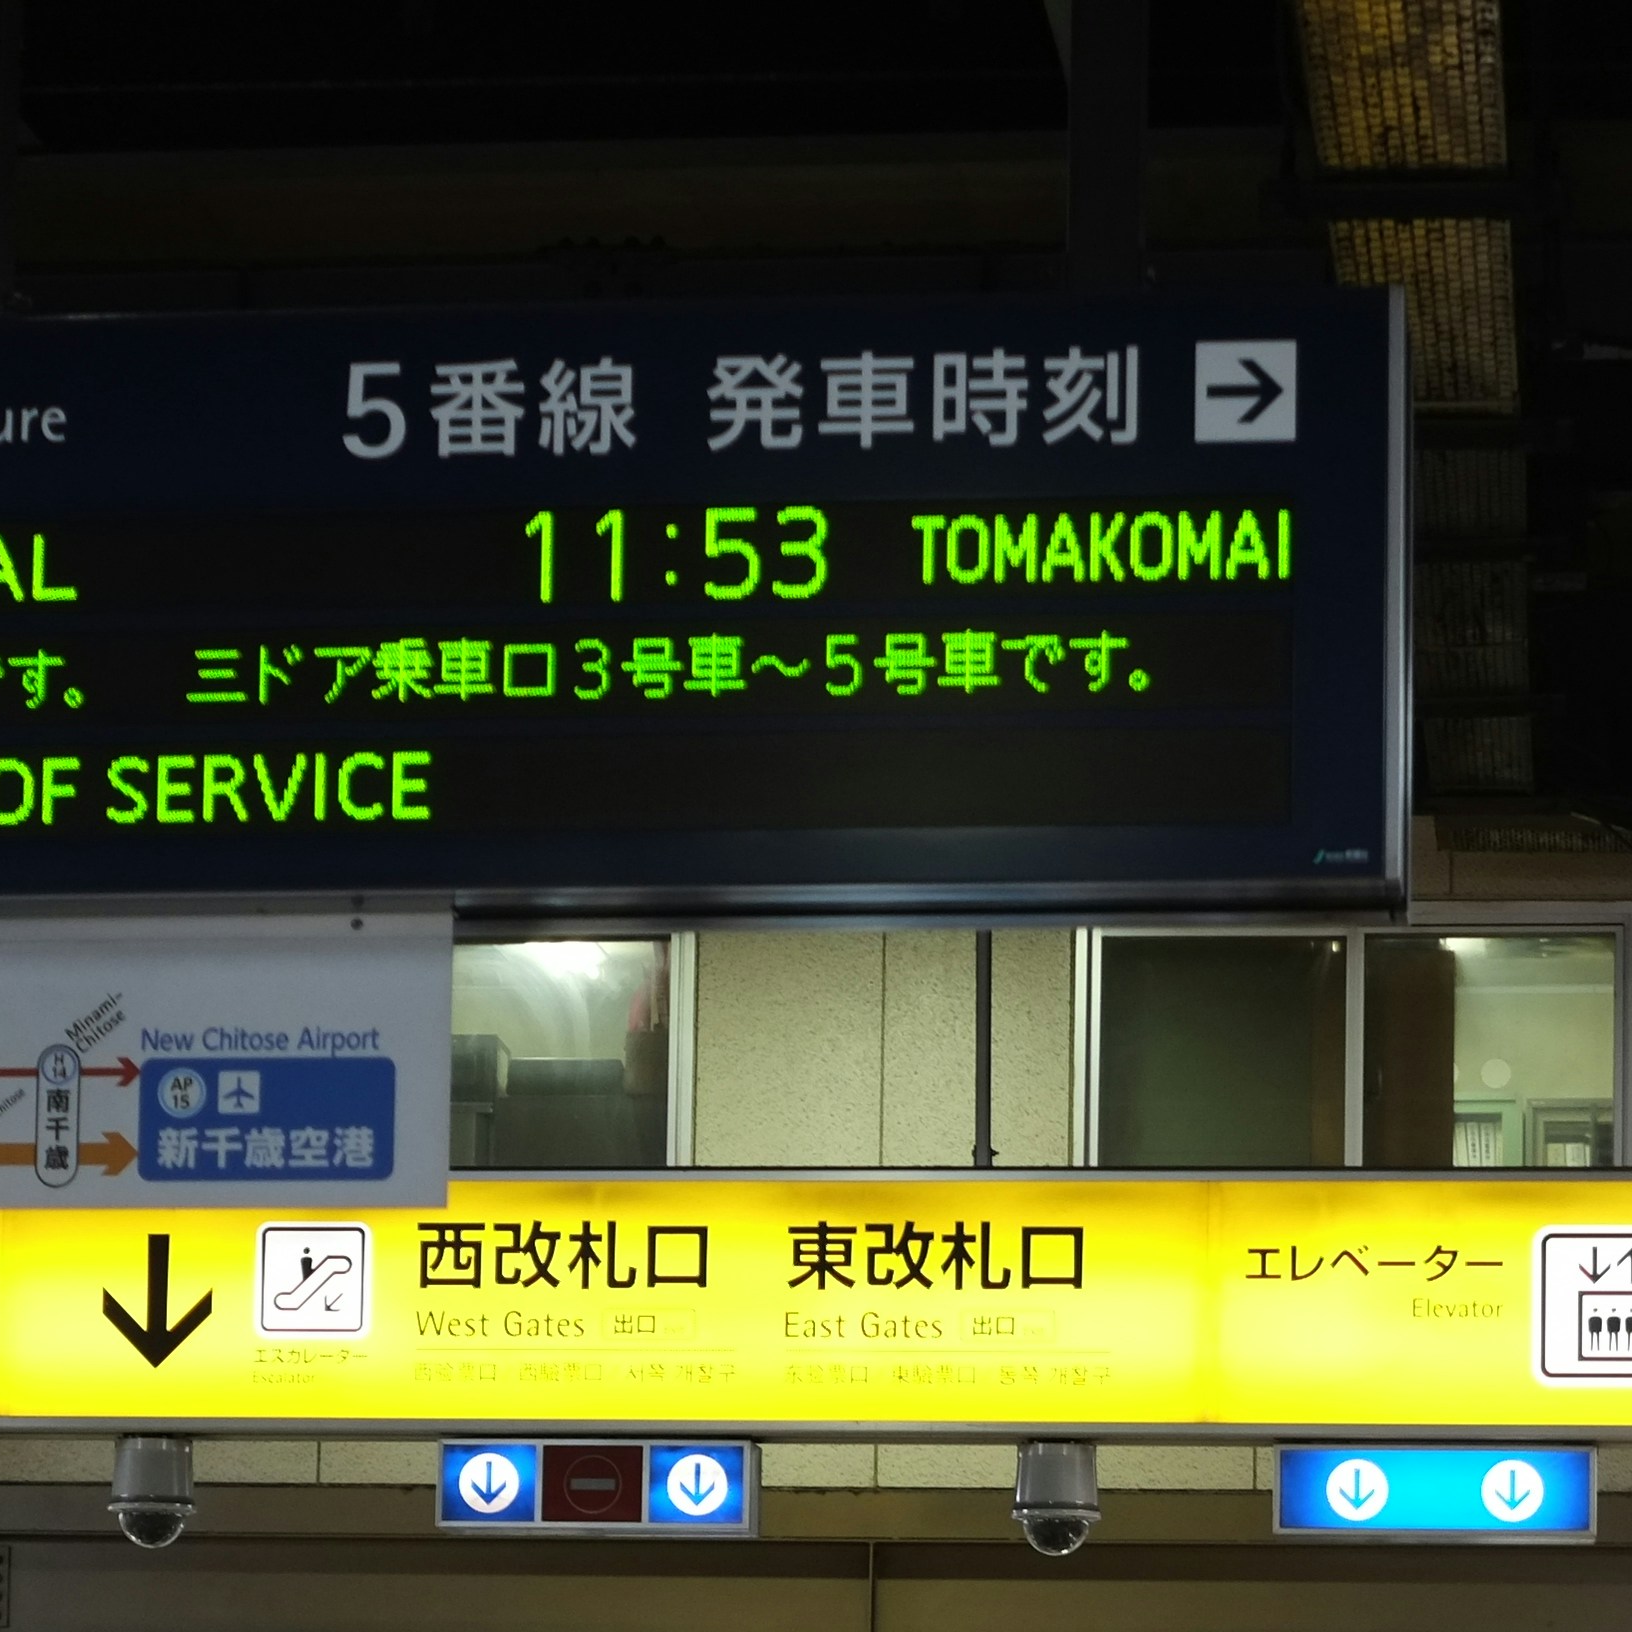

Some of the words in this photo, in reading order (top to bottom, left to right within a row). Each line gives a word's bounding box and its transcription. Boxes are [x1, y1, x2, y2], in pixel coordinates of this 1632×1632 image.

[340, 354, 638, 460] 5番線
[706, 345, 1142, 454] 発車時刻
[524, 505, 831, 604] 11:53
[912, 508, 1291, 586] TOMAKOMAI
[105, 750, 434, 826] SERVICE
[65, 989, 124, 1046] Minami-
[73, 1007, 128, 1056] Chitose
[140, 1026, 194, 1052] New
[200, 1024, 291, 1052] Chitose
[297, 1022, 381, 1057] Airport
[49, 1064, 71, 1080] 14
[53, 1053, 66, 1065] H
[169, 1073, 195, 1091] AP
[172, 1090, 194, 1109] 15
[45, 1087, 72, 1171] 南千歳
[156, 1125, 376, 1171] 新千歳空港
[415, 1218, 712, 1293] 西改札口
[786, 1218, 1088, 1293] 東改札口
[1245, 1243, 1505, 1284] エレベーター
[415, 1310, 489, 1338] West
[502, 1310, 586, 1339] Gates
[615, 1313, 658, 1336] 出口
[1410, 1296, 1505, 1321] Elevator
[783, 1310, 846, 1340] East
[860, 1310, 944, 1341] Gates
[971, 1314, 1016, 1338] 出口
[252, 1347, 369, 1365] エスカレーター
